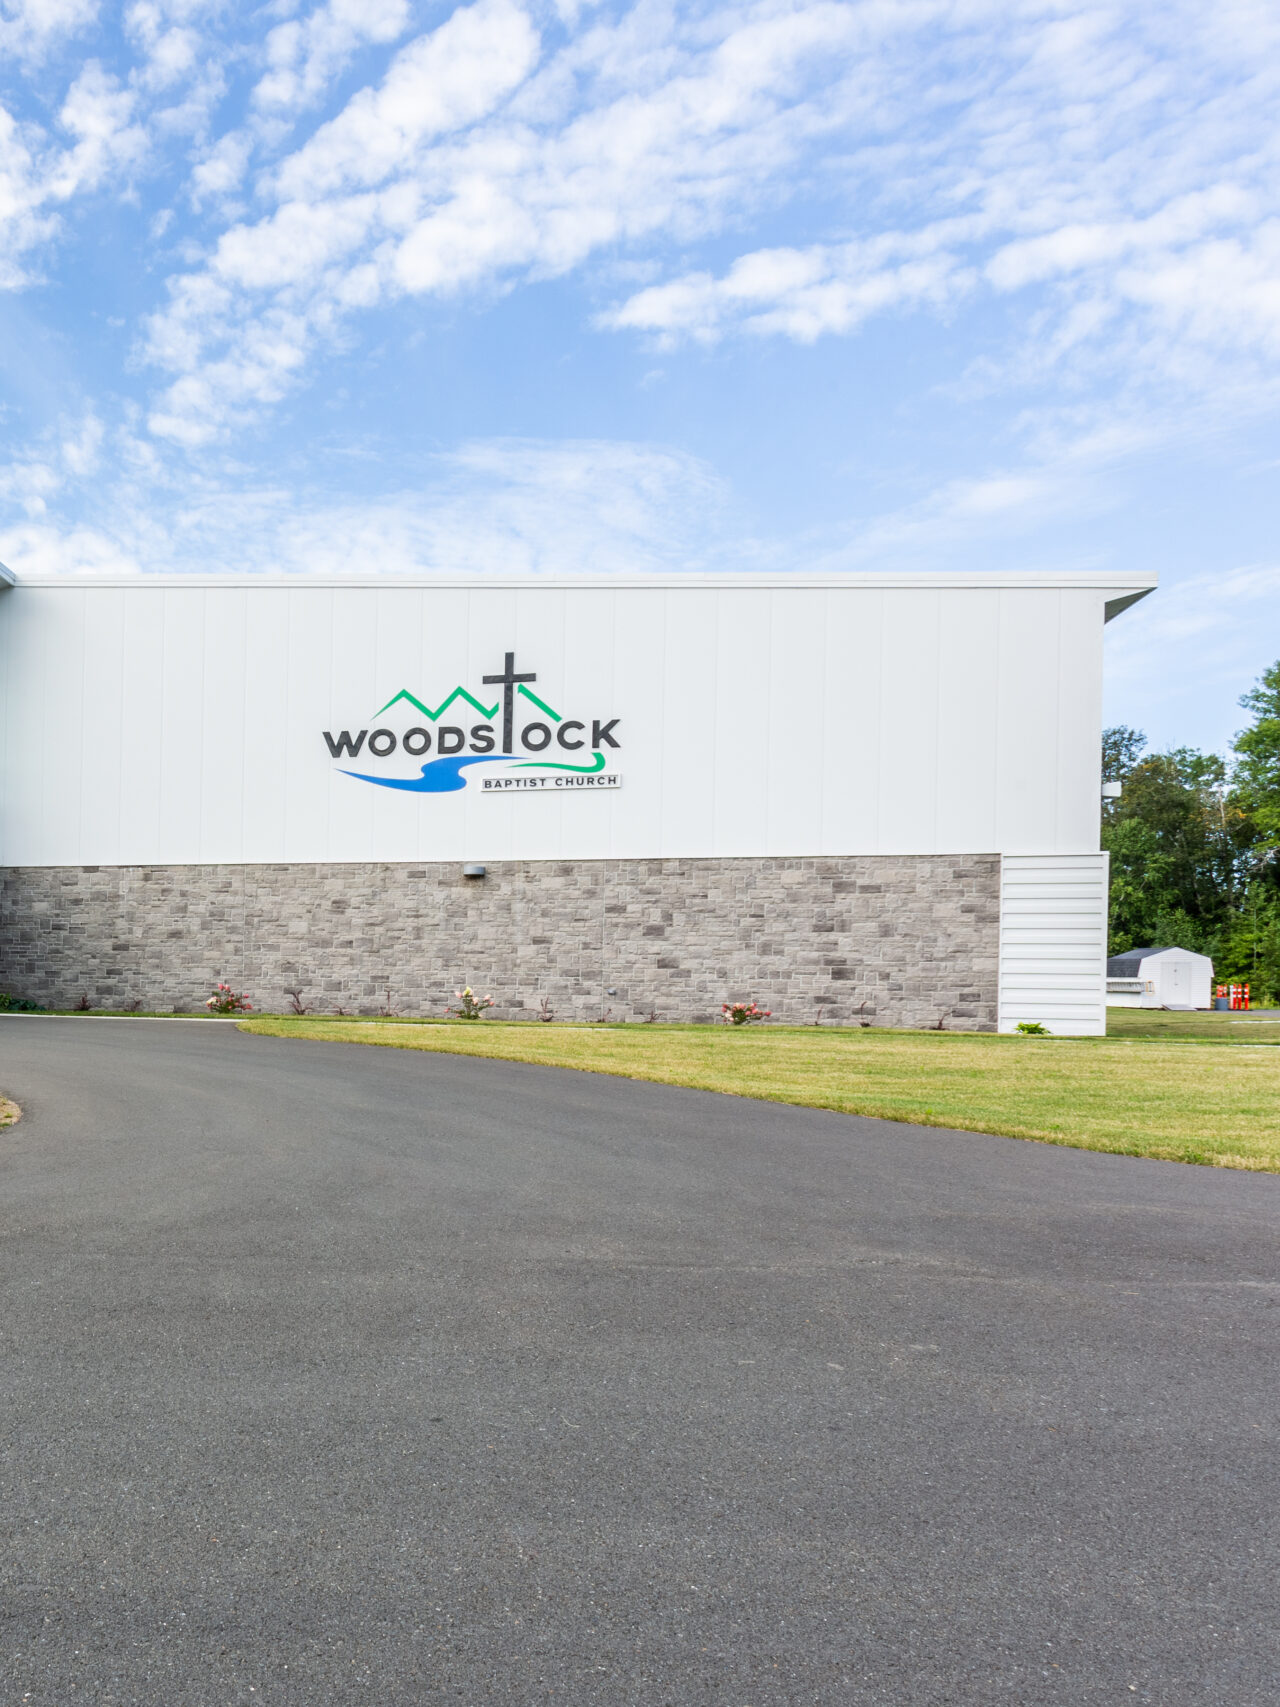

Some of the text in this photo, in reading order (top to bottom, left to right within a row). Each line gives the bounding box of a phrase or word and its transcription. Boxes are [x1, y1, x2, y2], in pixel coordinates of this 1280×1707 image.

[322, 651, 621, 758] WOODSTOCK
[484, 776, 617, 789] BAPTIST CHURCH
